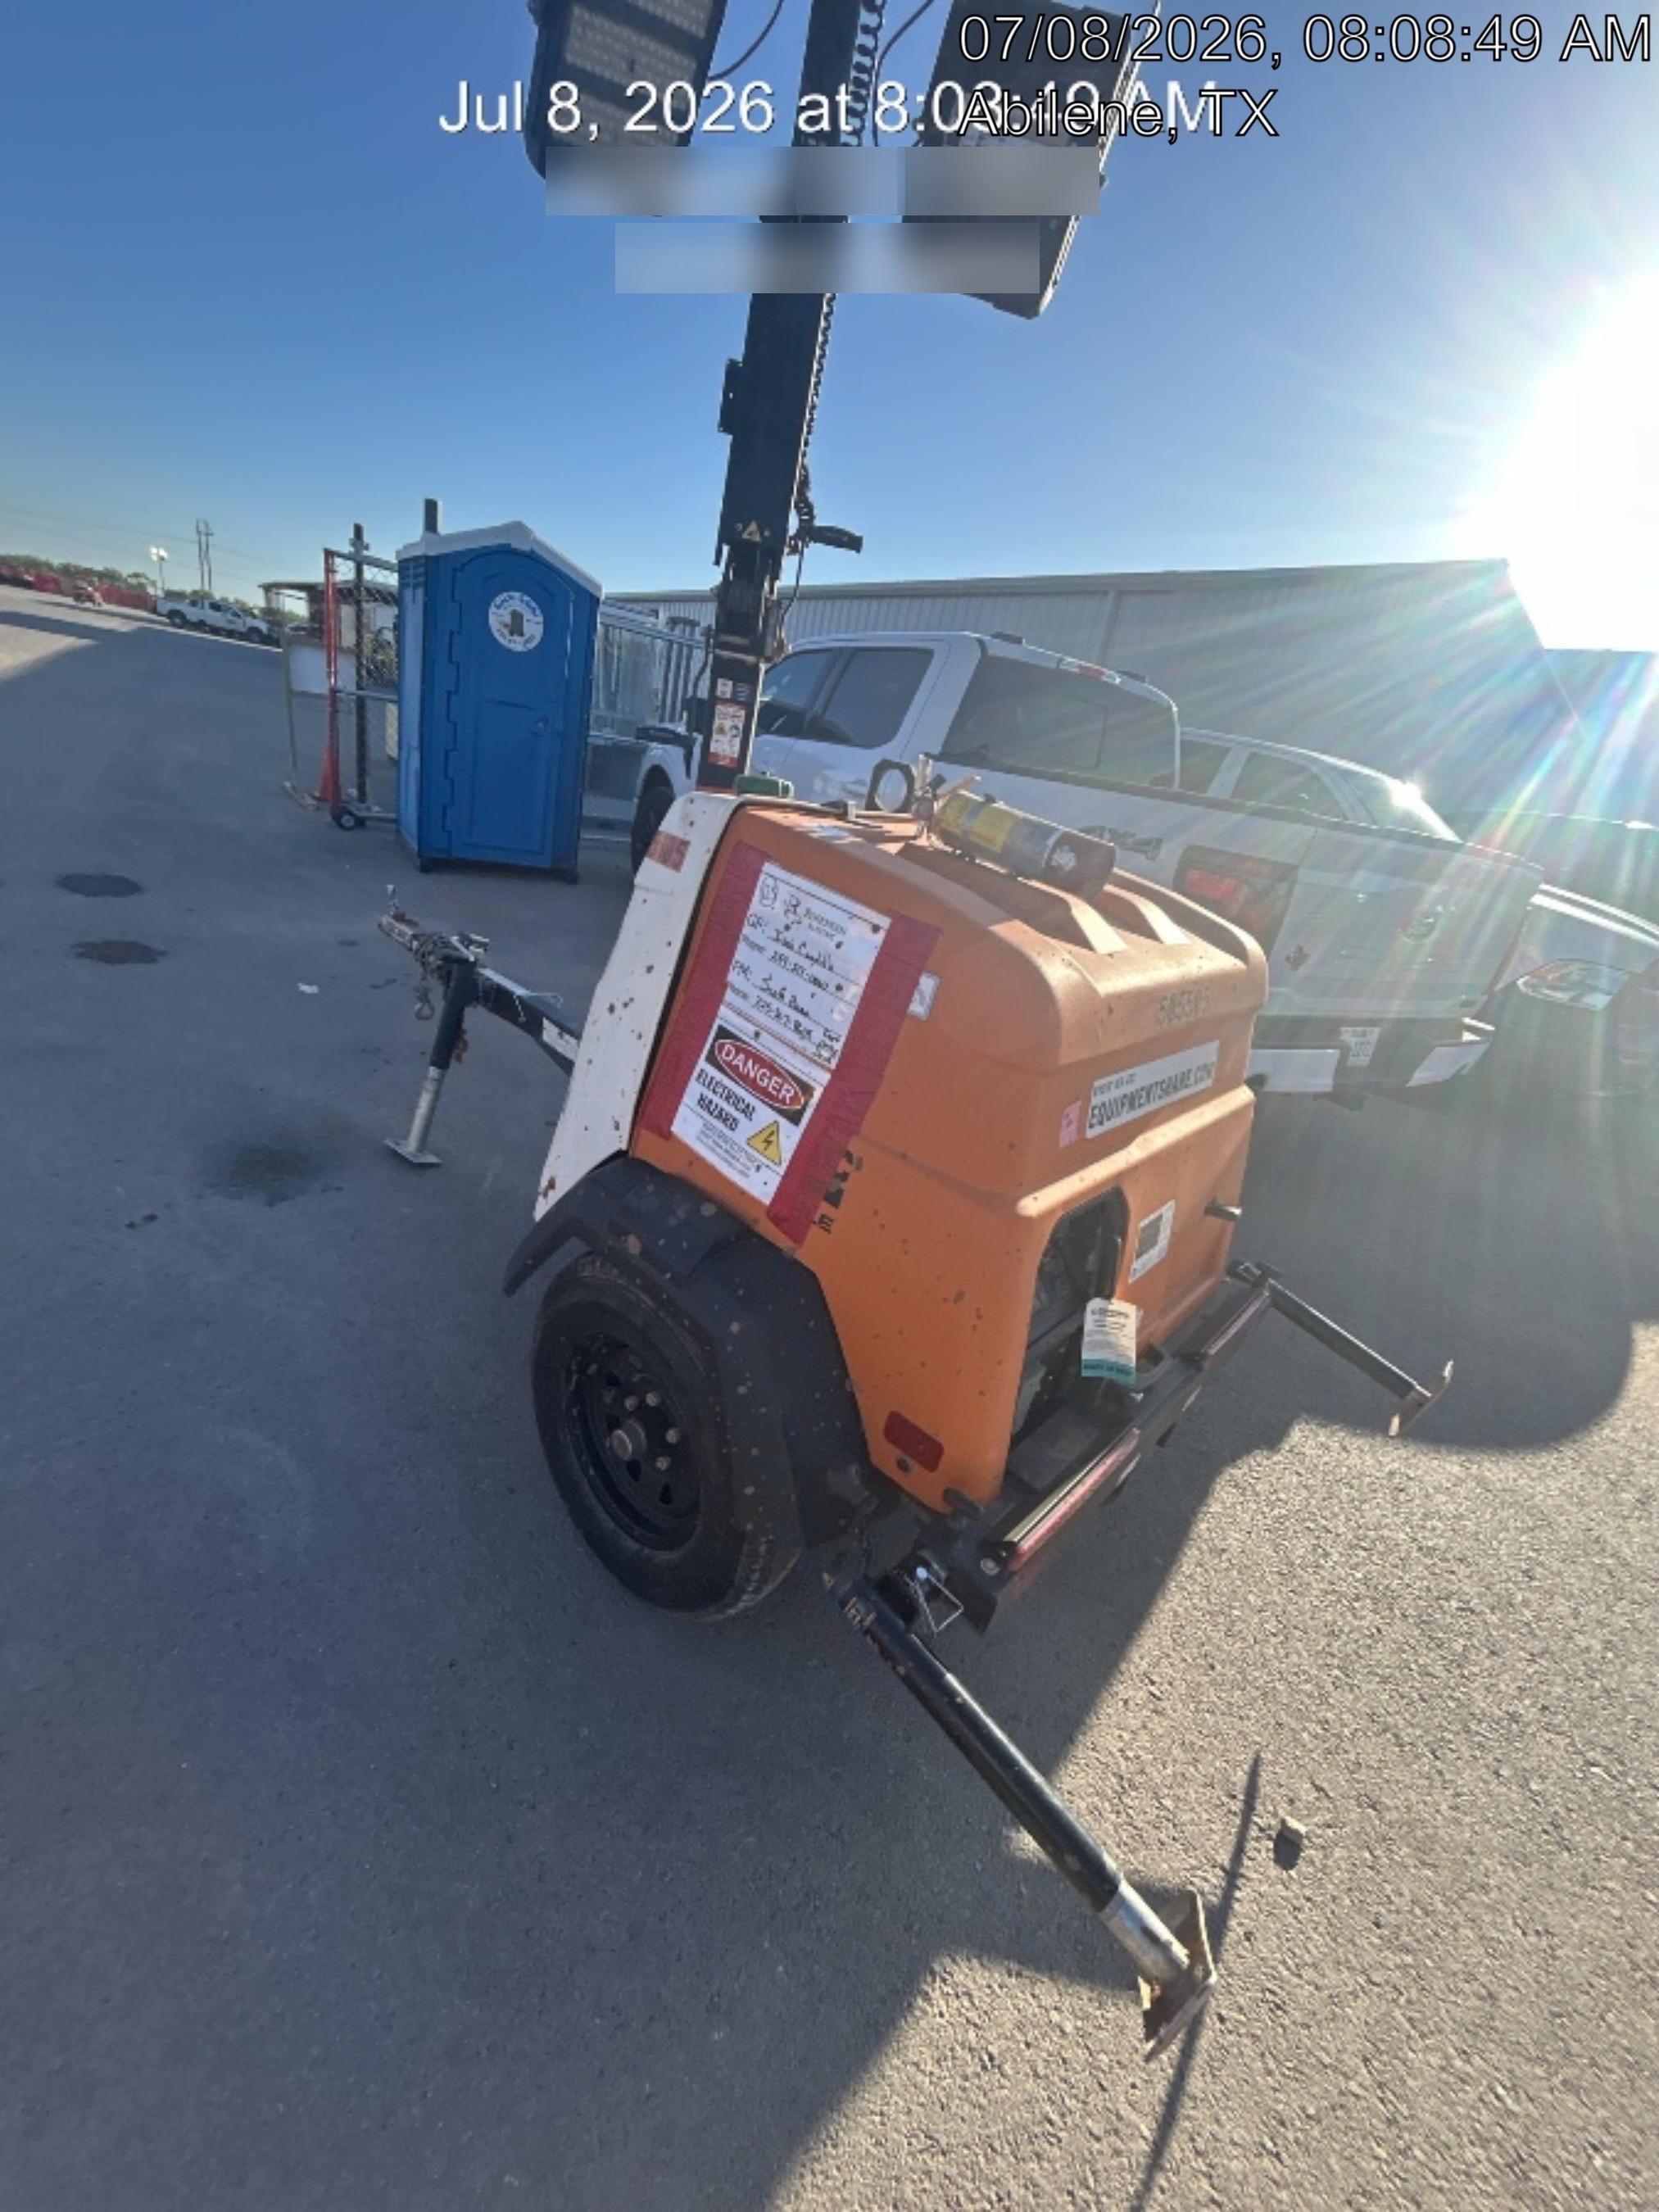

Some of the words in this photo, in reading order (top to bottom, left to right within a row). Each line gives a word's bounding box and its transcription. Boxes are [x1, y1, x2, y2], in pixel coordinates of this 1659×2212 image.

[696, 1067, 756, 1122] ELECTRICAL
[721, 1043, 795, 1104] DANGER
[697, 1092, 741, 1132] HAZARD
